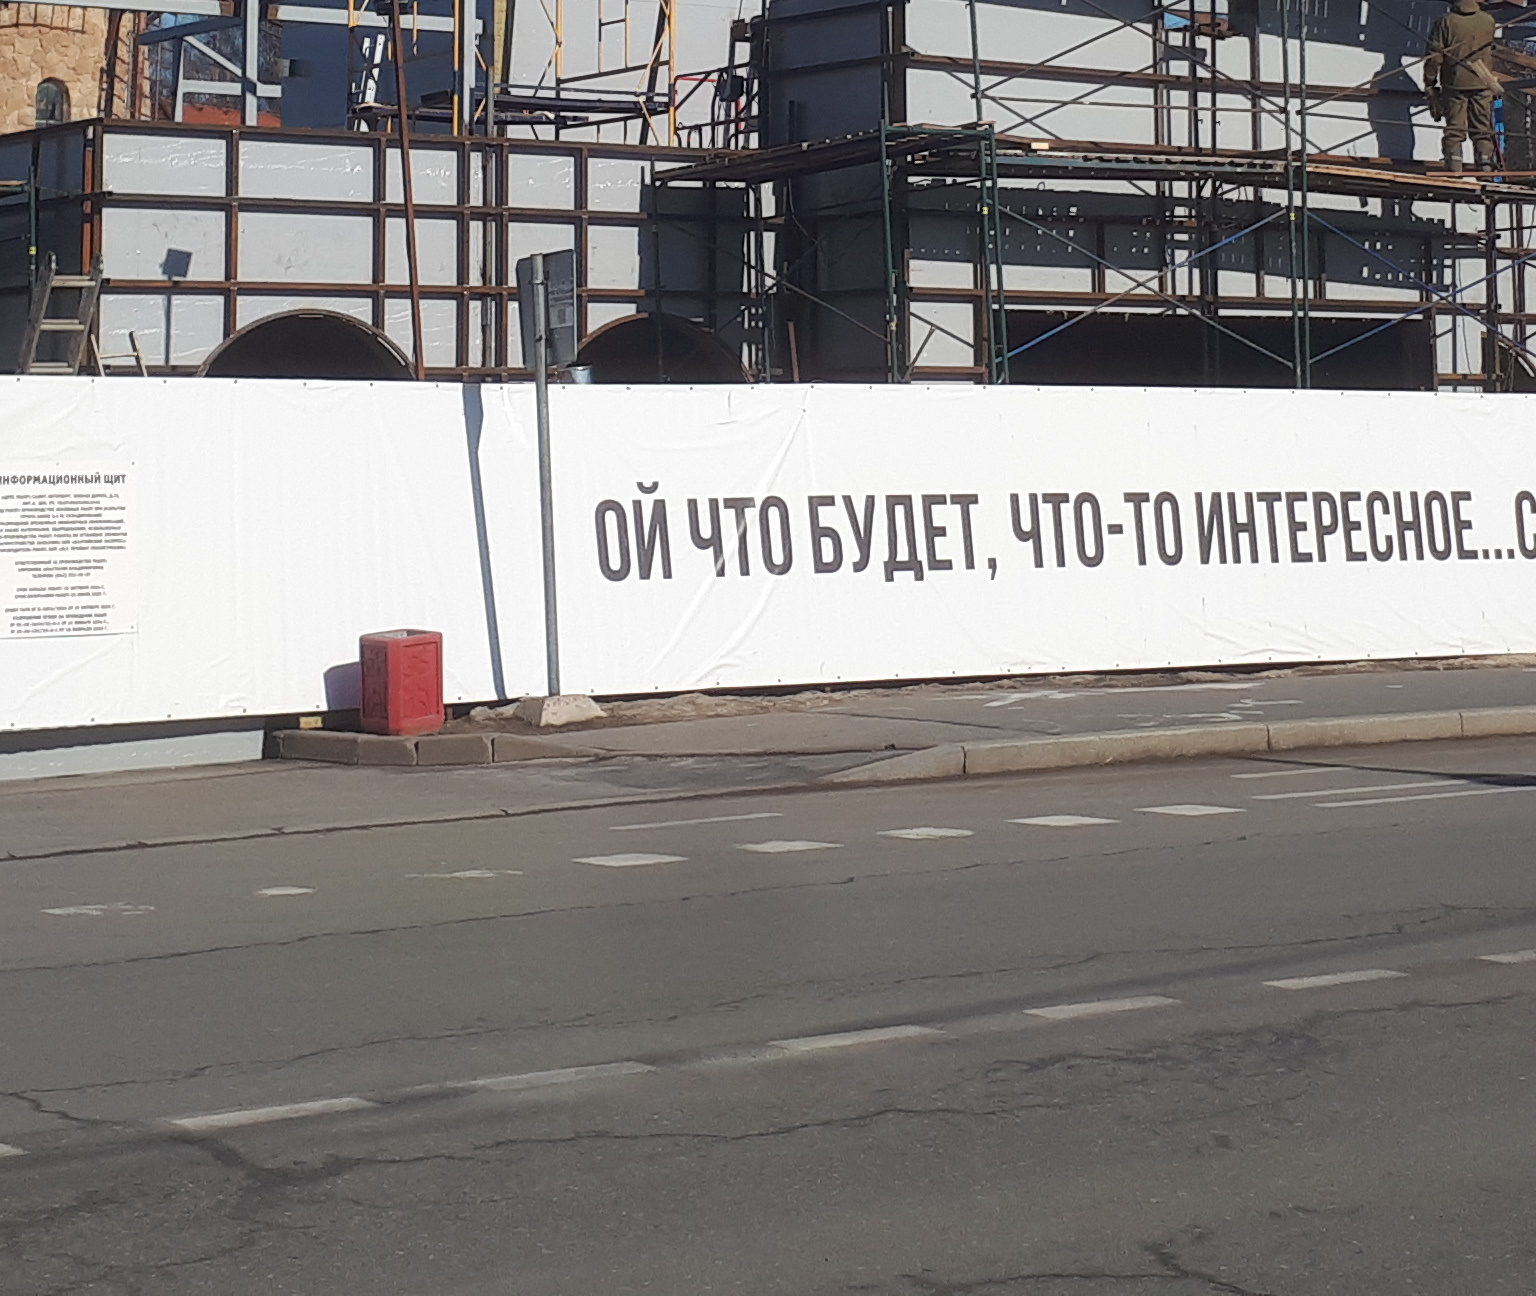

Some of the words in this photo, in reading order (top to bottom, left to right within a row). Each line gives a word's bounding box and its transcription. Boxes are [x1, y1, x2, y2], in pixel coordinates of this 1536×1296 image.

[103, 474, 126, 486] ЩИТ
[594, 481, 673, 582] ОЙ
[687, 495, 794, 578] ЧТО
[807, 493, 998, 583] БУДЕТ,
[1009, 491, 1183, 569] ЧТО-ТО
